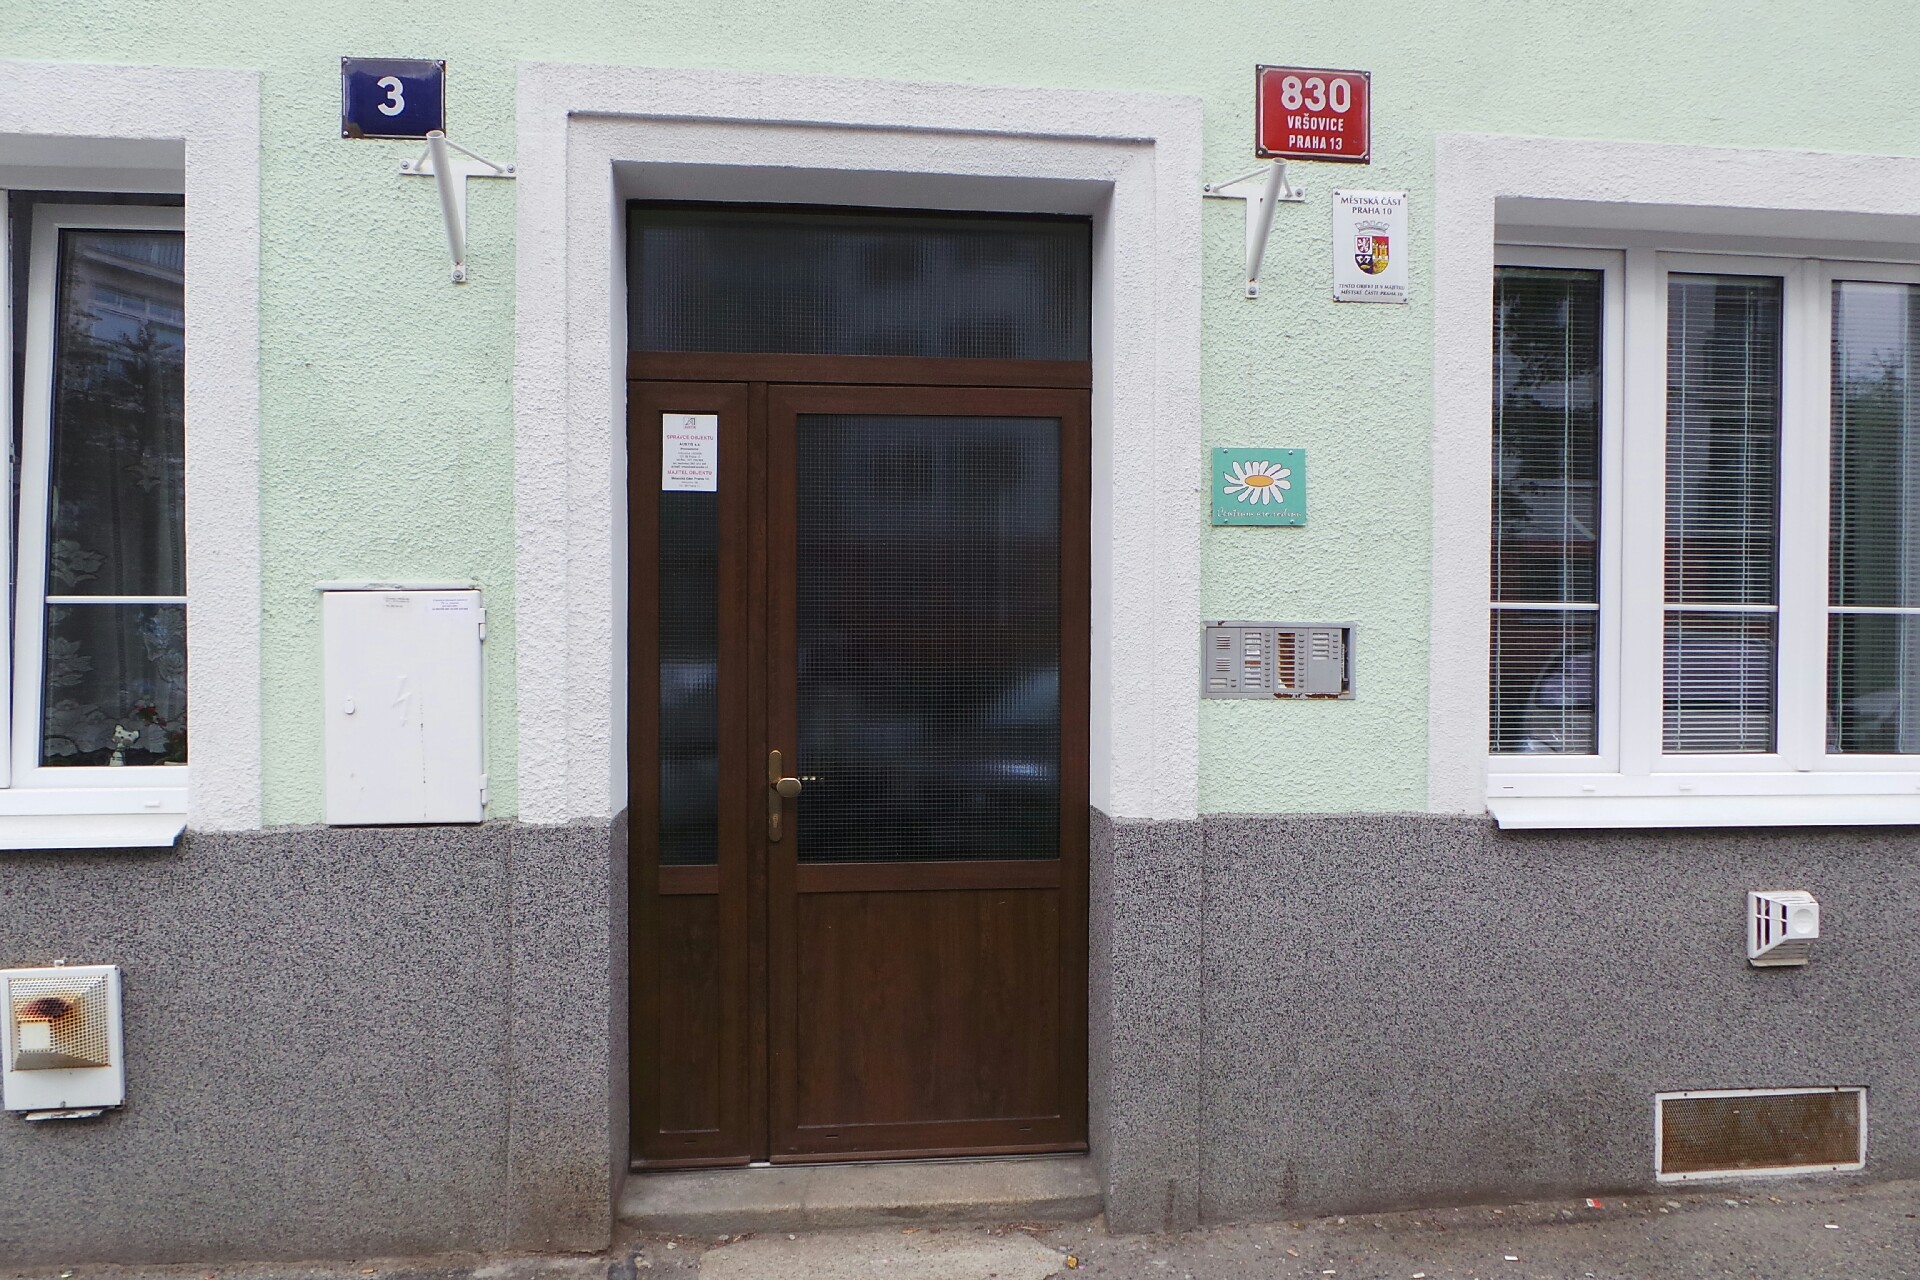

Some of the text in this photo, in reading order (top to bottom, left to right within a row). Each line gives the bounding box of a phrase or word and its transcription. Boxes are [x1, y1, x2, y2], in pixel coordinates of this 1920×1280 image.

[377, 76, 405, 116] 3
[1281, 75, 1351, 113] 830
[1287, 113, 1344, 131] VRŠOVICE
[1289, 134, 1343, 150] PRAHA 13
[1340, 195, 1402, 206] MĚSTSKÁ ČÁST
[1352, 207, 1380, 215] PRAHA
